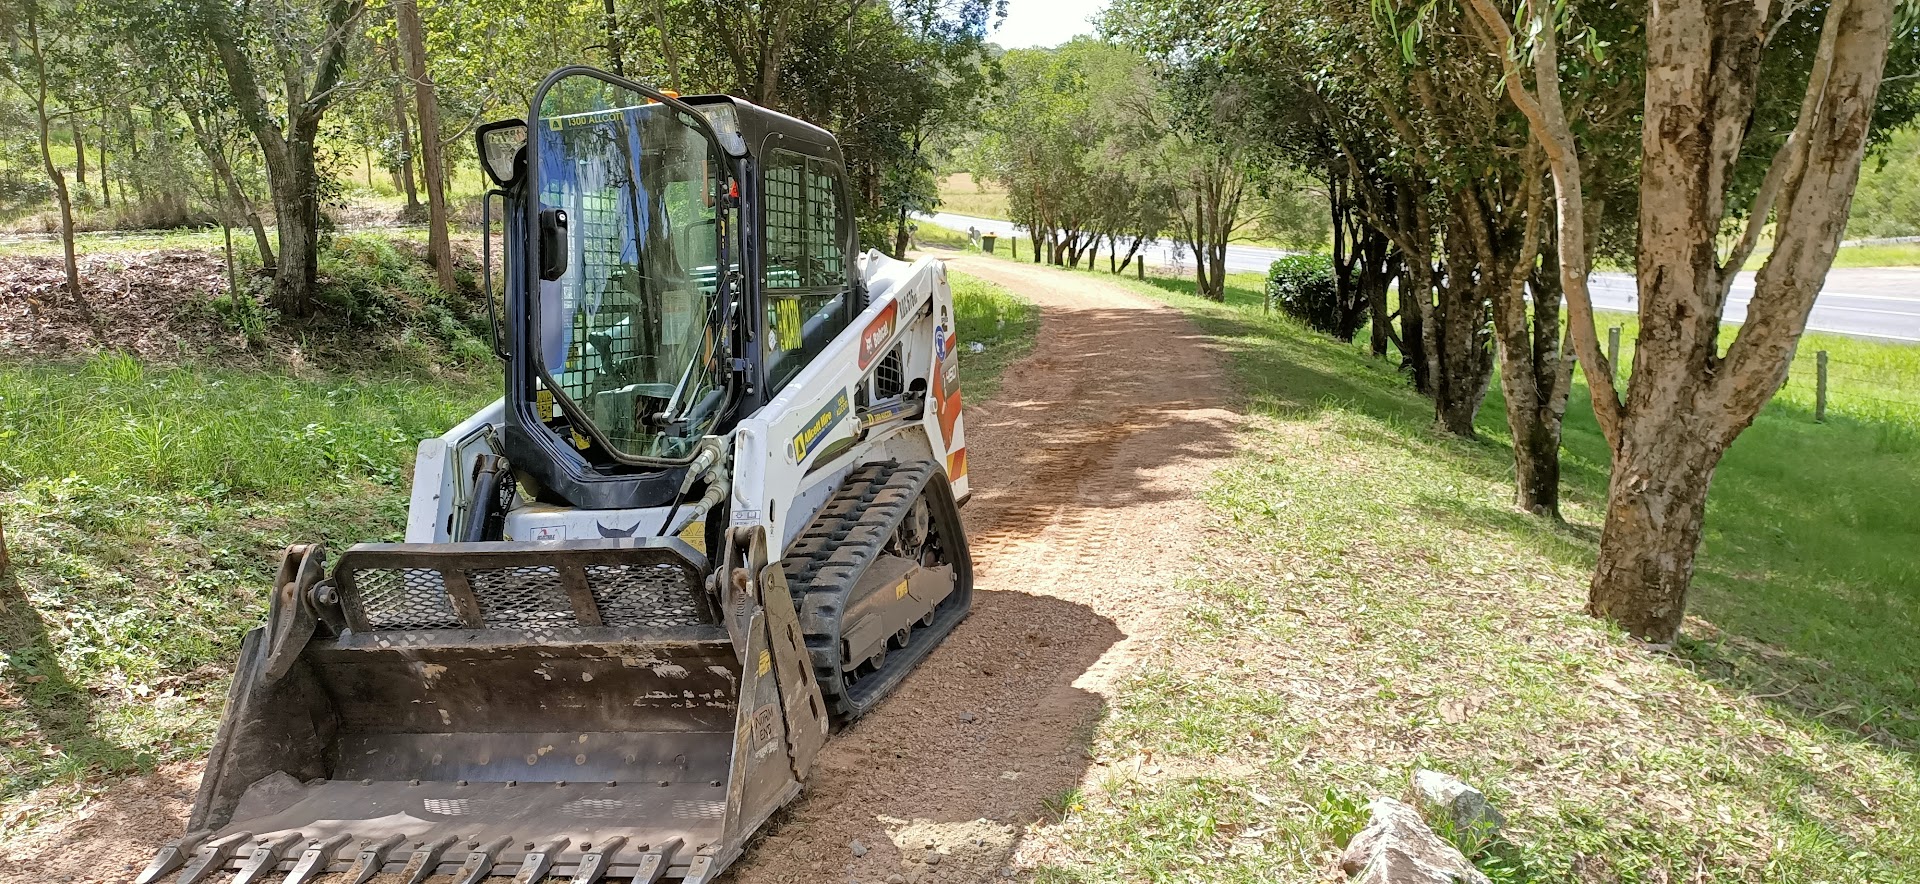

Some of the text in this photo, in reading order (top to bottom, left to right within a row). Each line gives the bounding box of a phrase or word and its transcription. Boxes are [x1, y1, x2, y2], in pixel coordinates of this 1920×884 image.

[568, 112, 625, 126] 1300 ALLCOTT
[872, 320, 889, 348] Bobcat
[804, 420, 822, 444] Allcott
[820, 411, 833, 428] Hire
